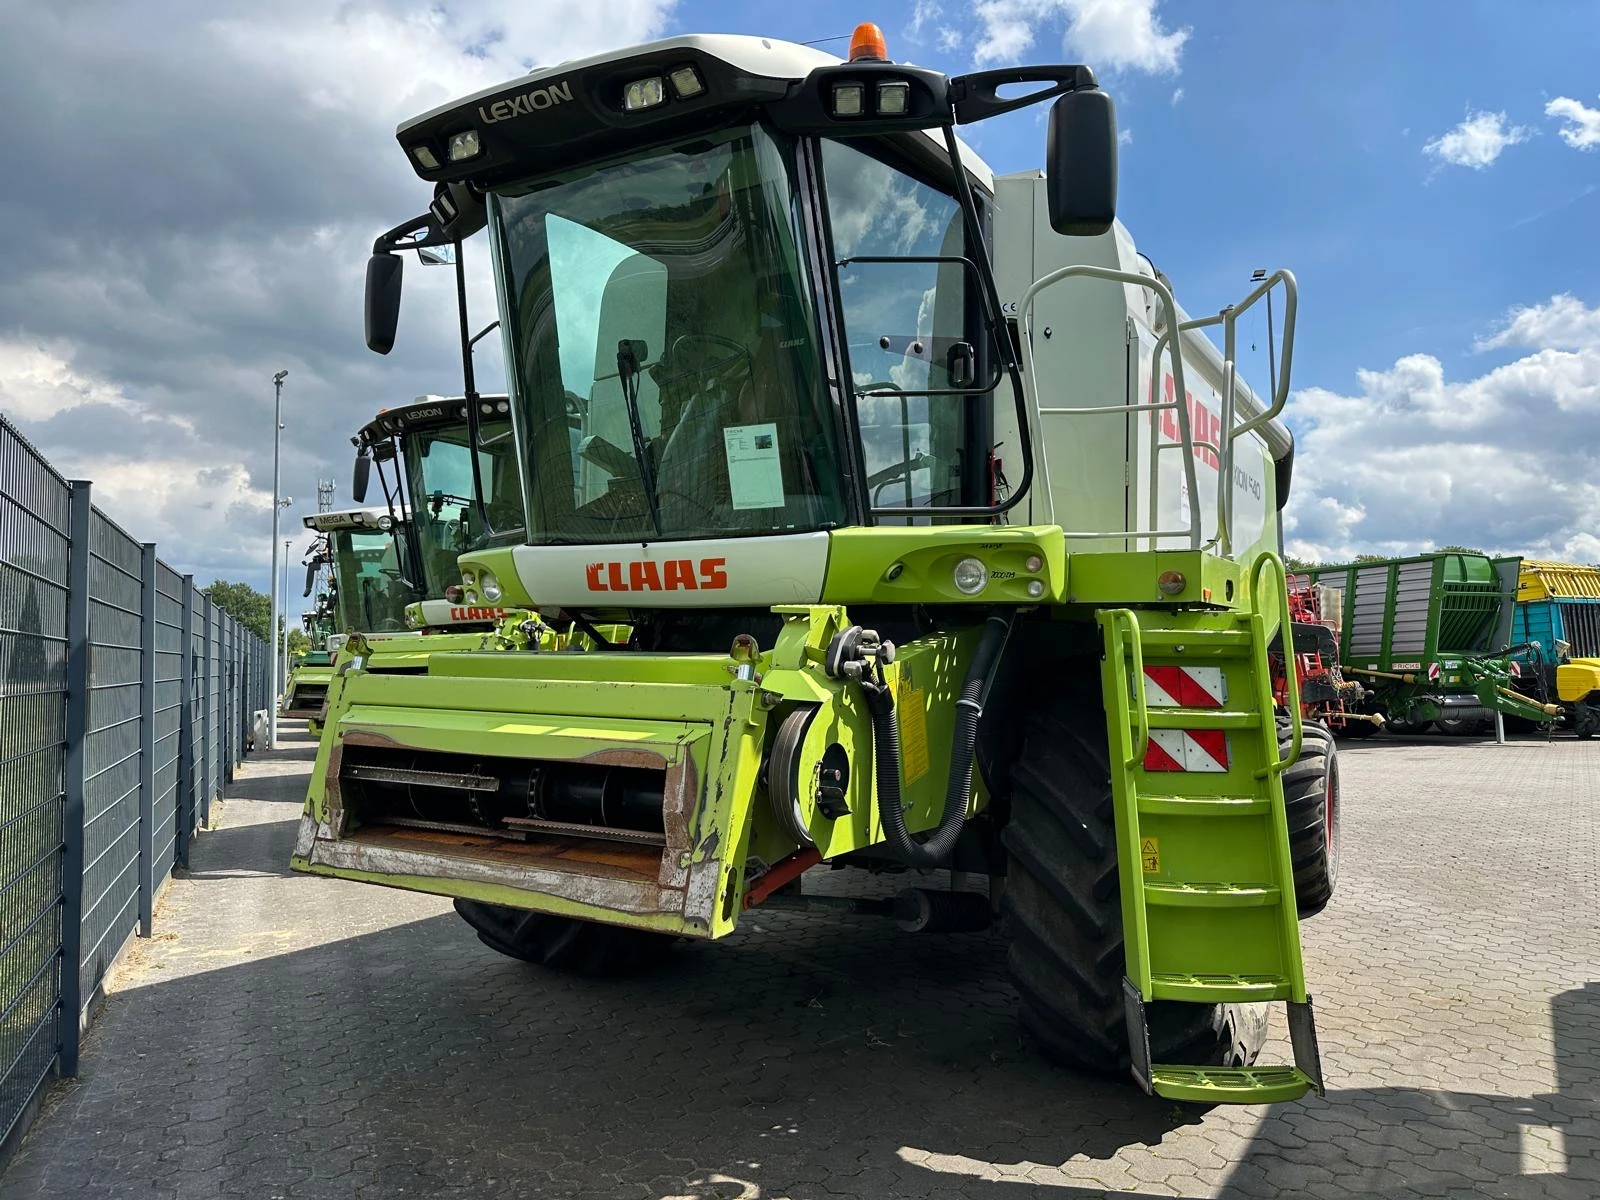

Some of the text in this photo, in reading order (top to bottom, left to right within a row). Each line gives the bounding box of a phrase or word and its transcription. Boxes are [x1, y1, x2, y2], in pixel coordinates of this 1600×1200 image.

[478, 80, 574, 124] LEXION
[406, 408, 443, 420] LEXION
[1148, 372, 1220, 471] LAS
[319, 514, 346, 526] MEGA
[586, 557, 728, 591] CLAAS
[450, 607, 508, 621] CLAAS
[1392, 662, 1420, 670] FRICKE
